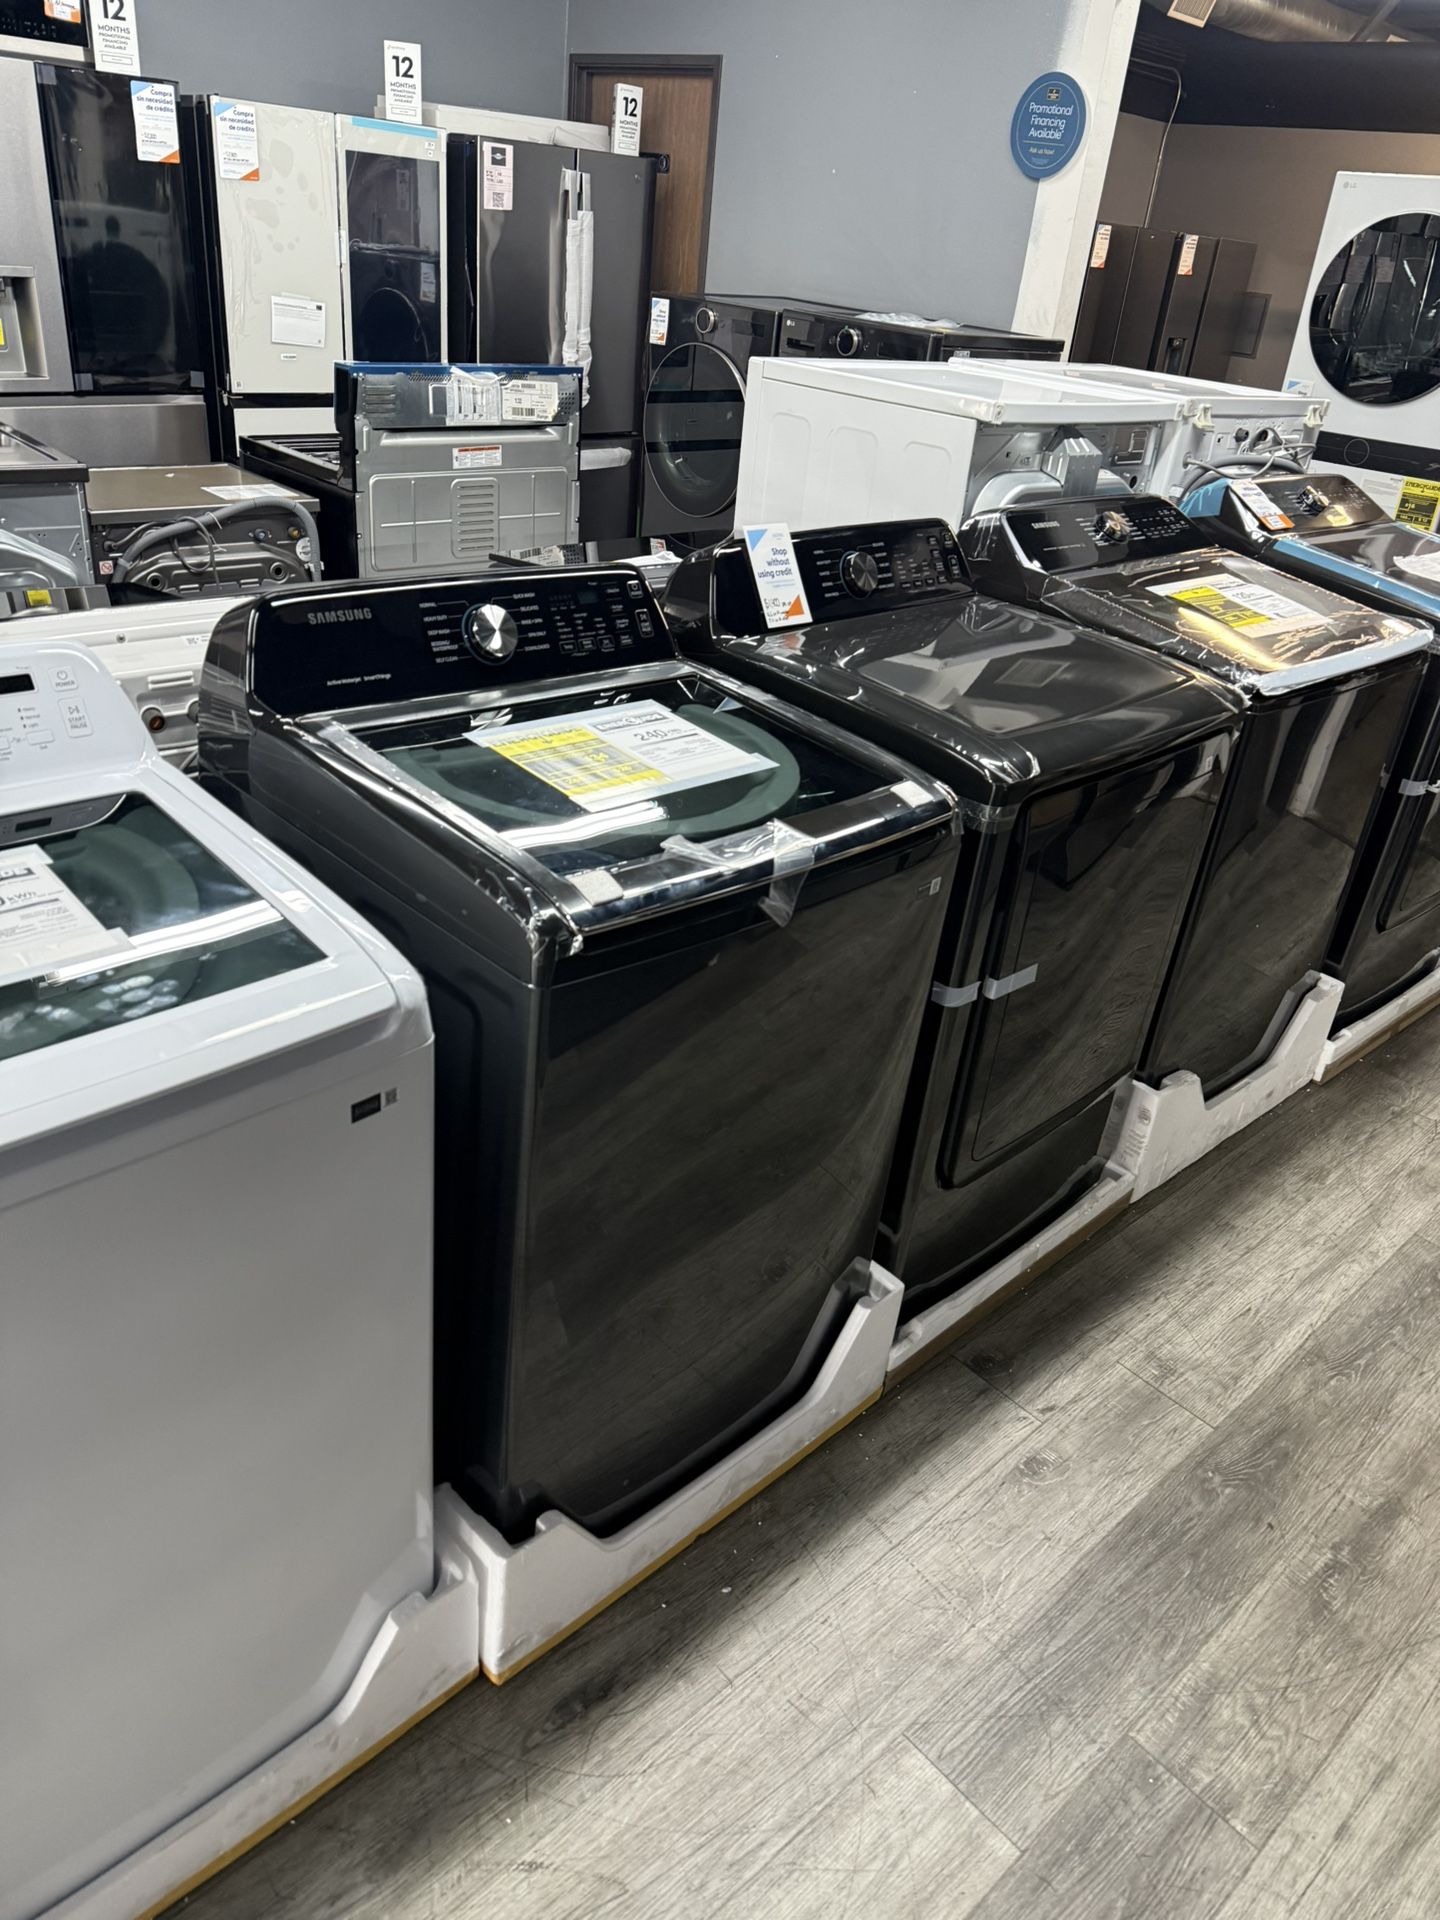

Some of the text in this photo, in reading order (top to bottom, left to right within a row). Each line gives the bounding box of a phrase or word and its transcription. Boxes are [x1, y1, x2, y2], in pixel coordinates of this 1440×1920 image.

[102, 0, 126, 21] 12
[97, 24, 131, 35] MONTHS
[98, 32, 131, 41] PROMOTIONAL
[102, 38, 129, 46] FINANCING
[392, 55, 414, 79] 12
[390, 82, 417, 90] MONTHS
[150, 89, 173, 98] Compra
[136, 95, 174, 105] sin necesidad
[154, 105, 174, 113] crédito
[623, 96, 638, 118] 12
[1029, 102, 1074, 116] Promotional
[233, 109, 254, 118] Compra
[228, 116, 255, 125] necesidad
[1030, 114, 1066, 130] Financing
[236, 125, 255, 133] crédito
[1032, 521, 1060, 529] SAMSUNG
[771, 547, 788, 557] Shop
[766, 558, 791, 567] without
[757, 567, 793, 579] using credit
[307, 607, 373, 625] SAMSUNG
[55, 679, 76, 688] POWER
[67, 714, 86, 724] START
[69, 720, 88, 729] PAUSE
[633, 728, 667, 742] 240
